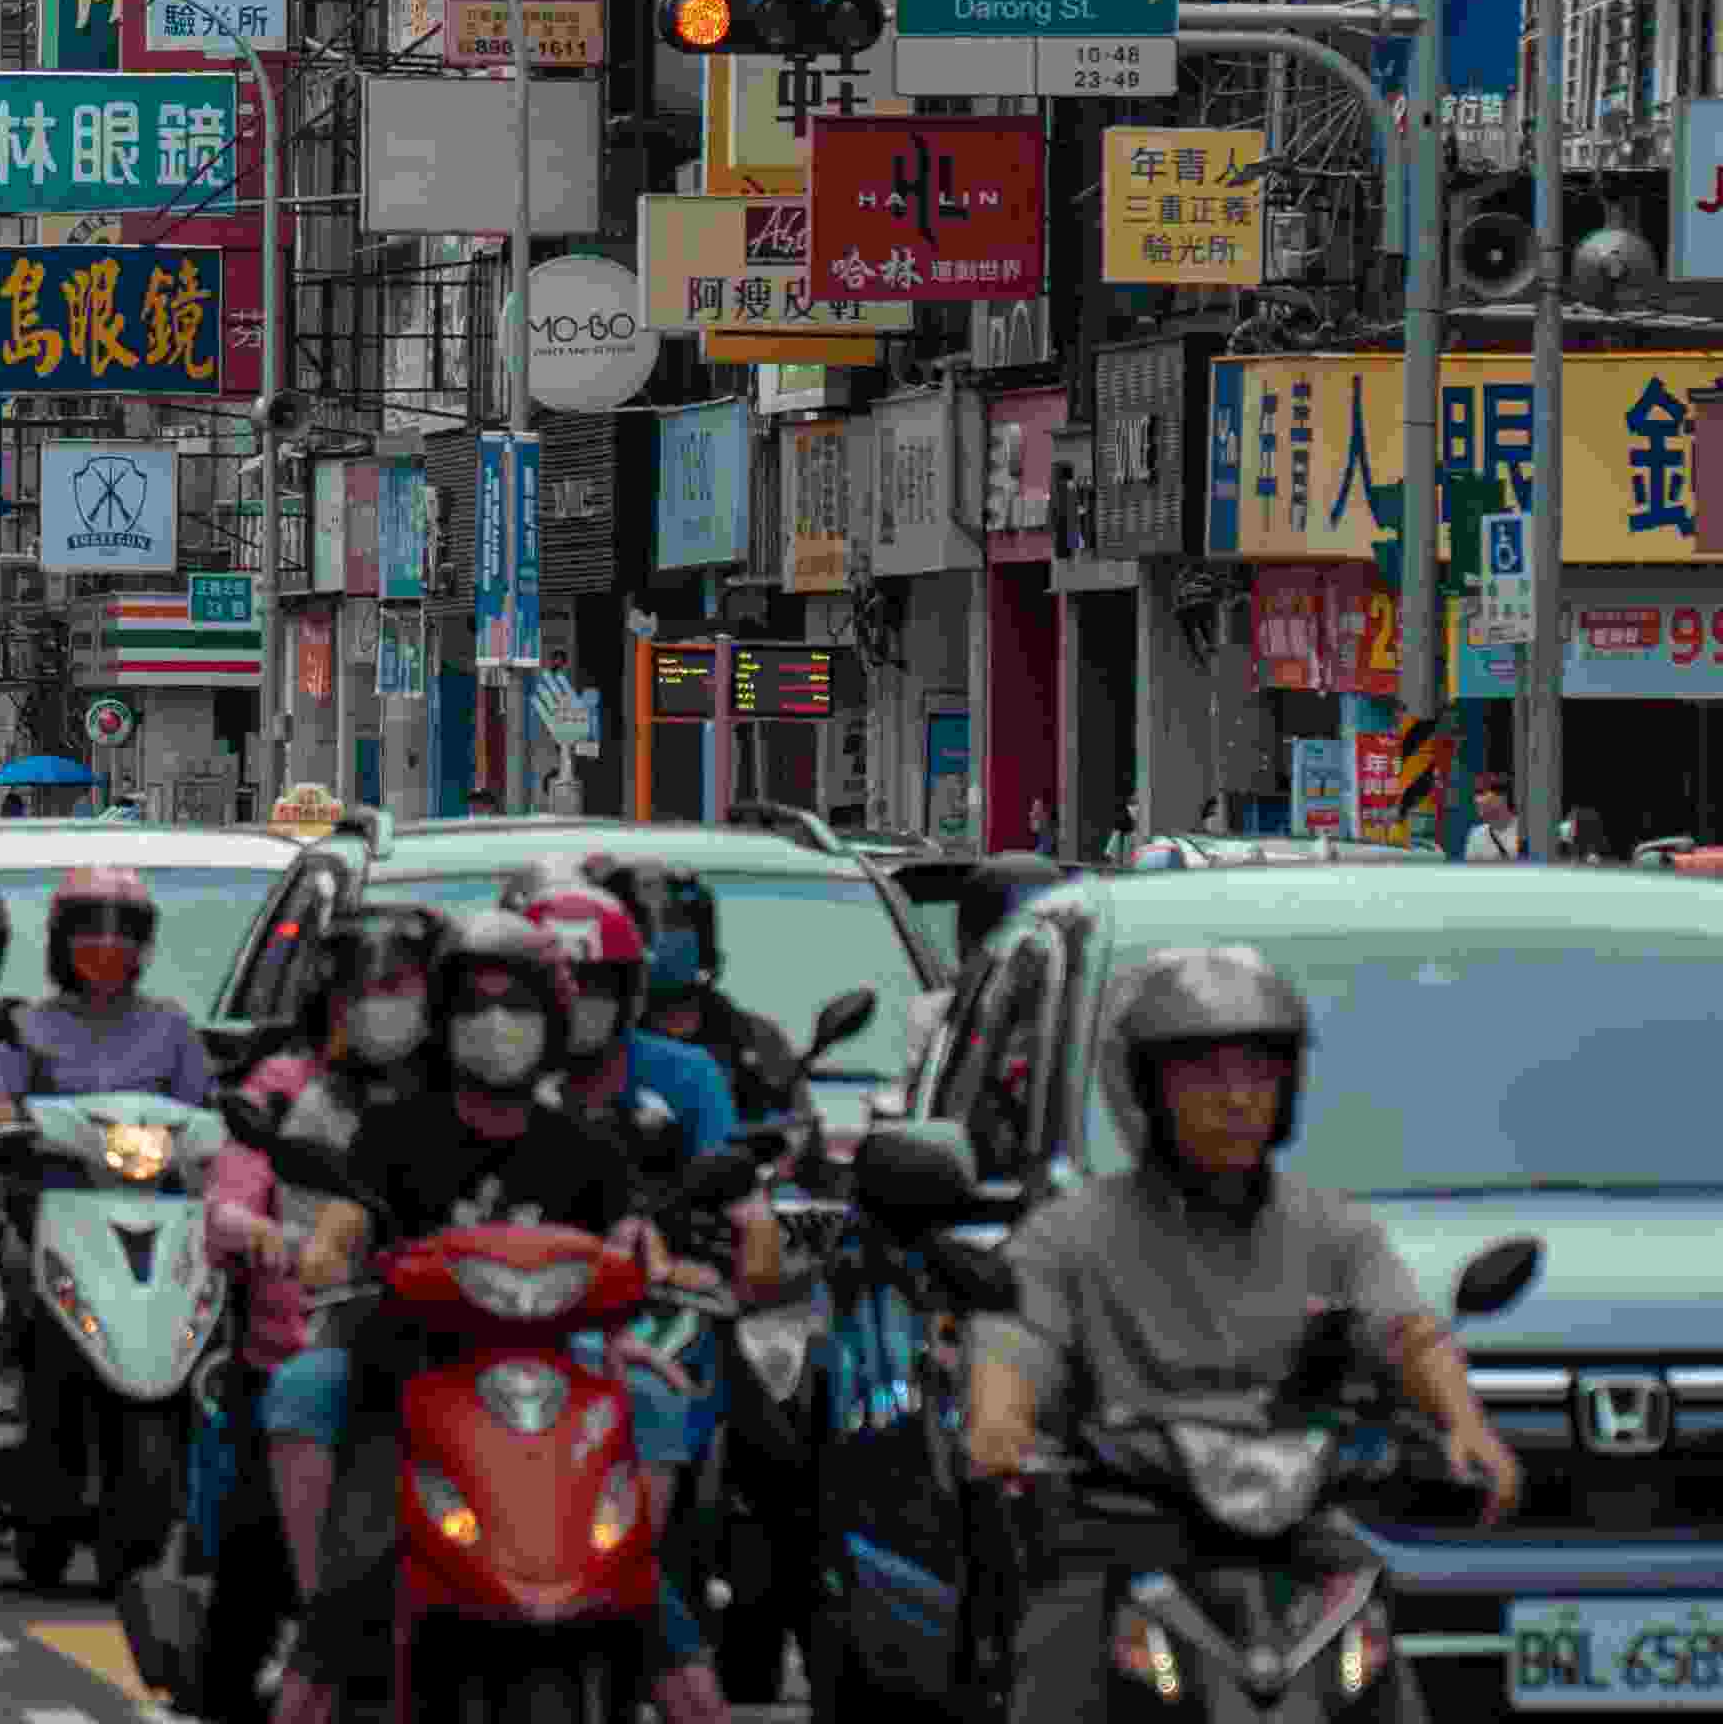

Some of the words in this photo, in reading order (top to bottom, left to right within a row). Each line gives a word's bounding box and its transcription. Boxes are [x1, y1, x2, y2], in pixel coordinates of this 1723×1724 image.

[164, 5, 268, 37] 驗光所
[829, 243, 925, 291] 哈林
